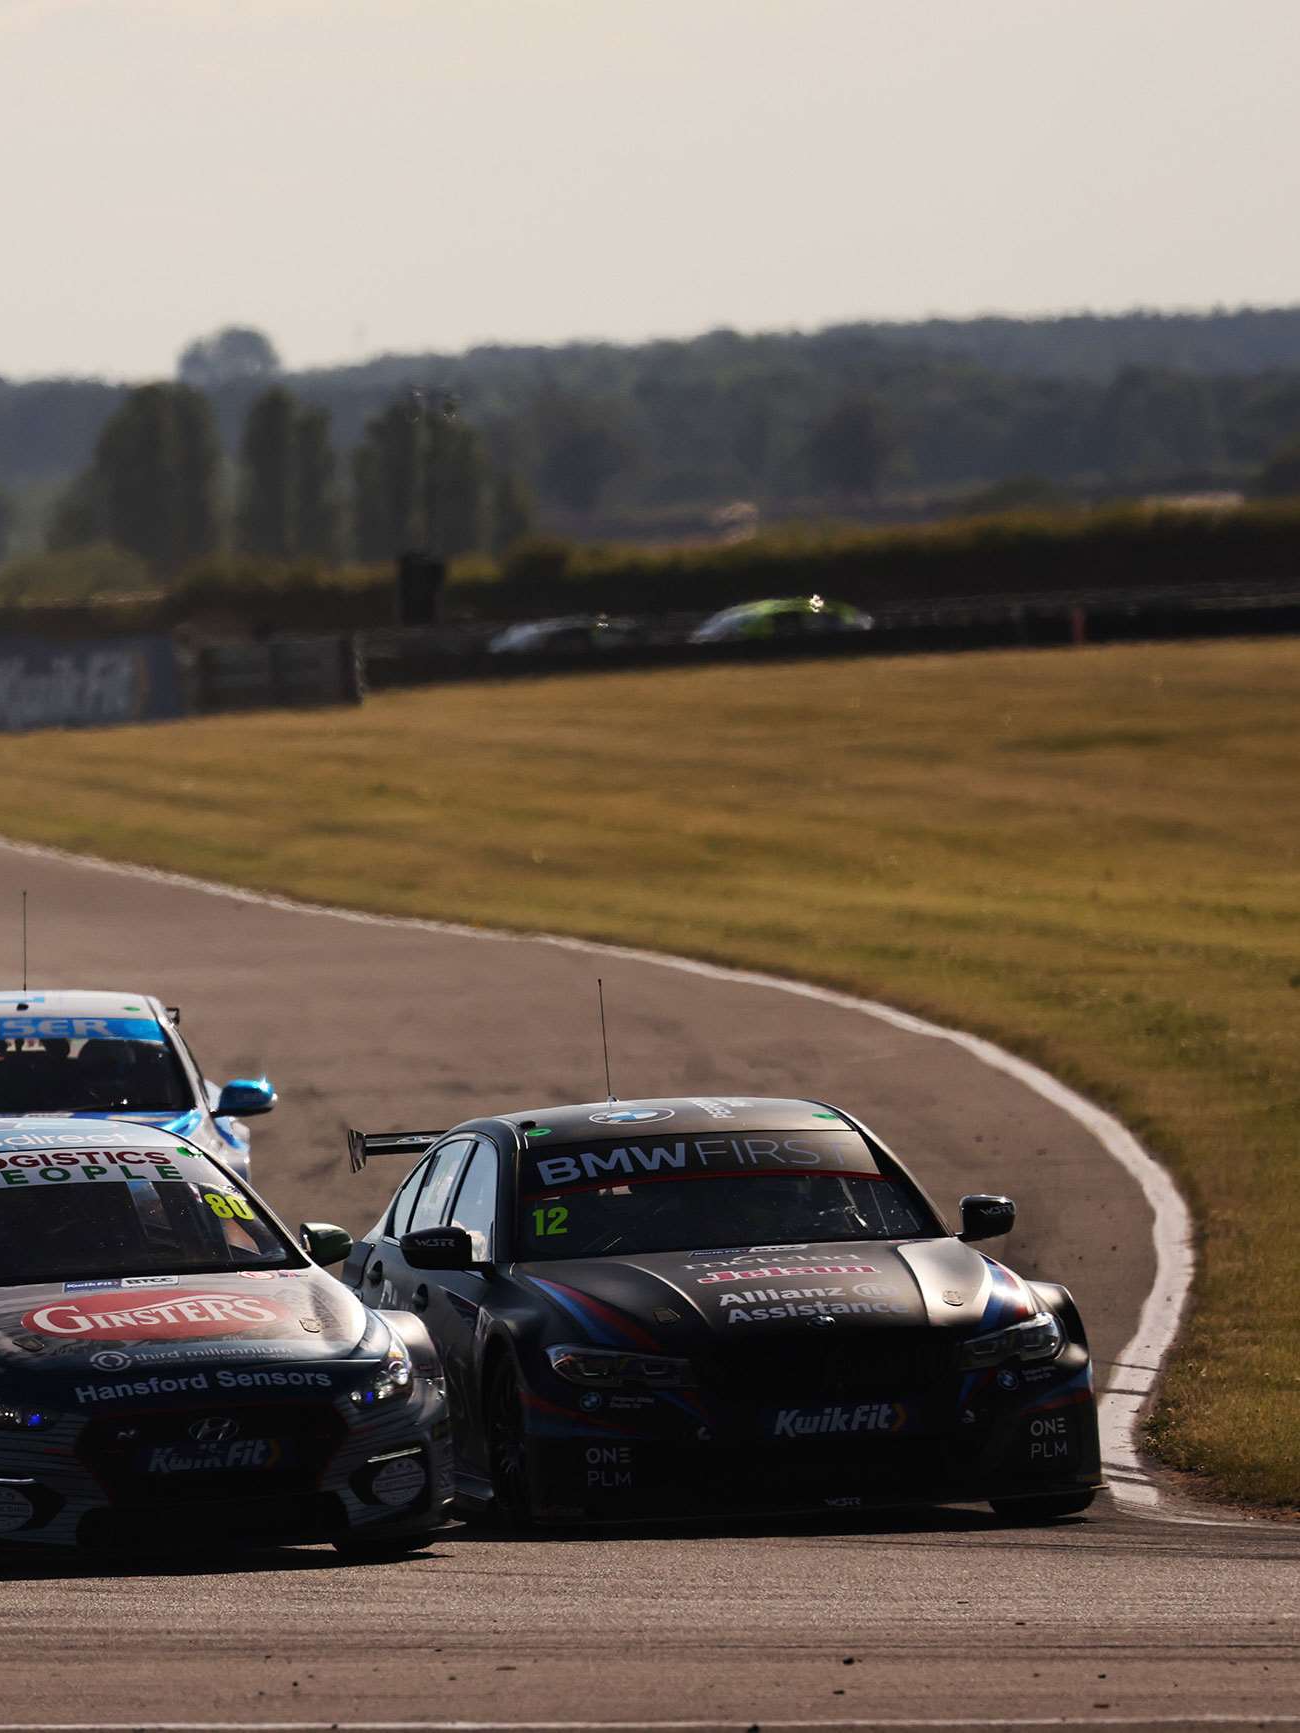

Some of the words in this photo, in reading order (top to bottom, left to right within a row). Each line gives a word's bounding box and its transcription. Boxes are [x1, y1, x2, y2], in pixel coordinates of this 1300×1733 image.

[203, 1192, 255, 1221] 80
[532, 1206, 570, 1237] 12
[719, 1286, 846, 1306] Allianz
[728, 1301, 909, 1325] Assistance
[135, 1350, 179, 1361] third
[75, 1373, 209, 1404] Hansford
[215, 1369, 333, 1388] Sensors
[1030, 1417, 1068, 1436] ONE
[585, 1447, 633, 1464] ONE
[1030, 1441, 1068, 1460] PLM
[587, 1470, 633, 1488] PLM
